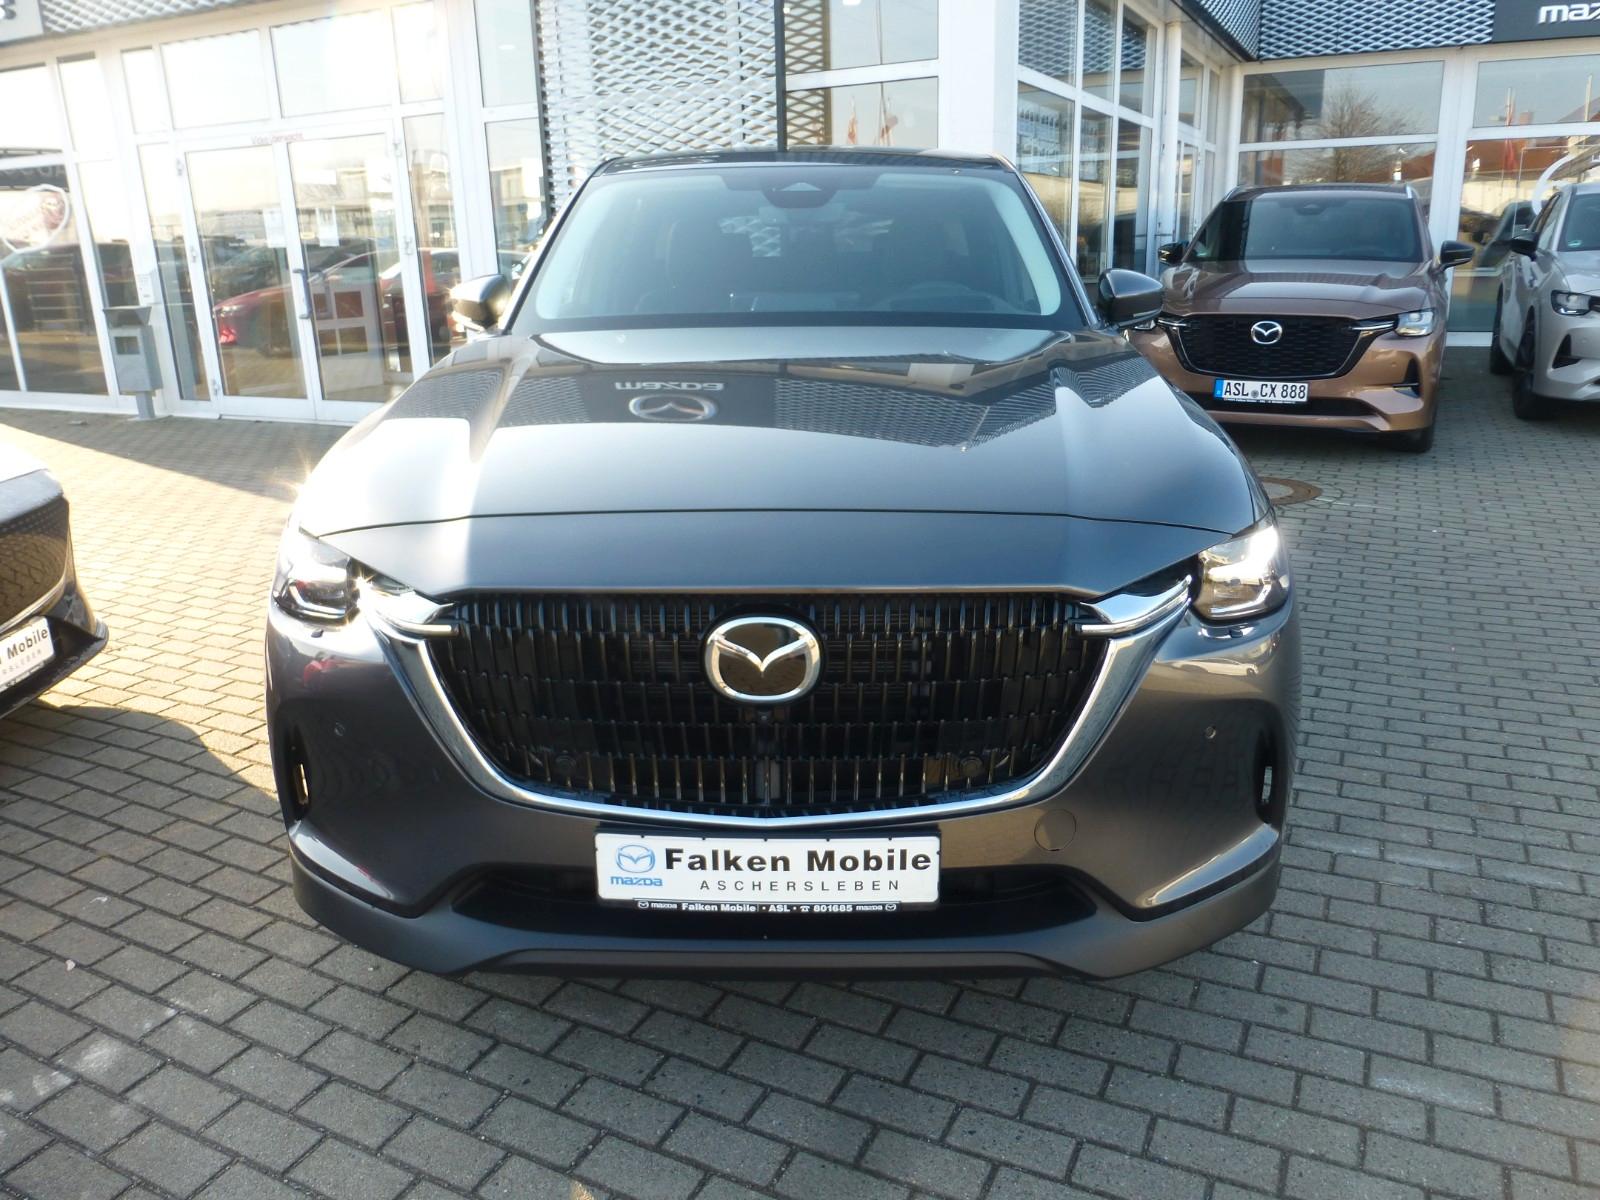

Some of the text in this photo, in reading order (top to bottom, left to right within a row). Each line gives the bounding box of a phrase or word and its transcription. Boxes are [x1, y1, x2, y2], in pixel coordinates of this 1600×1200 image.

[1224, 382, 1306, 399] ASL CX 888
[7, 628, 49, 660] Mobile
[665, 847, 931, 872] Falken Mobile
[610, 876, 663, 887] mazda
[699, 880, 899, 892] ASCHERSLEBEN
[682, 902, 718, 911] Falken
[720, 903, 756, 912] Mobile
[769, 904, 791, 913] ASL
